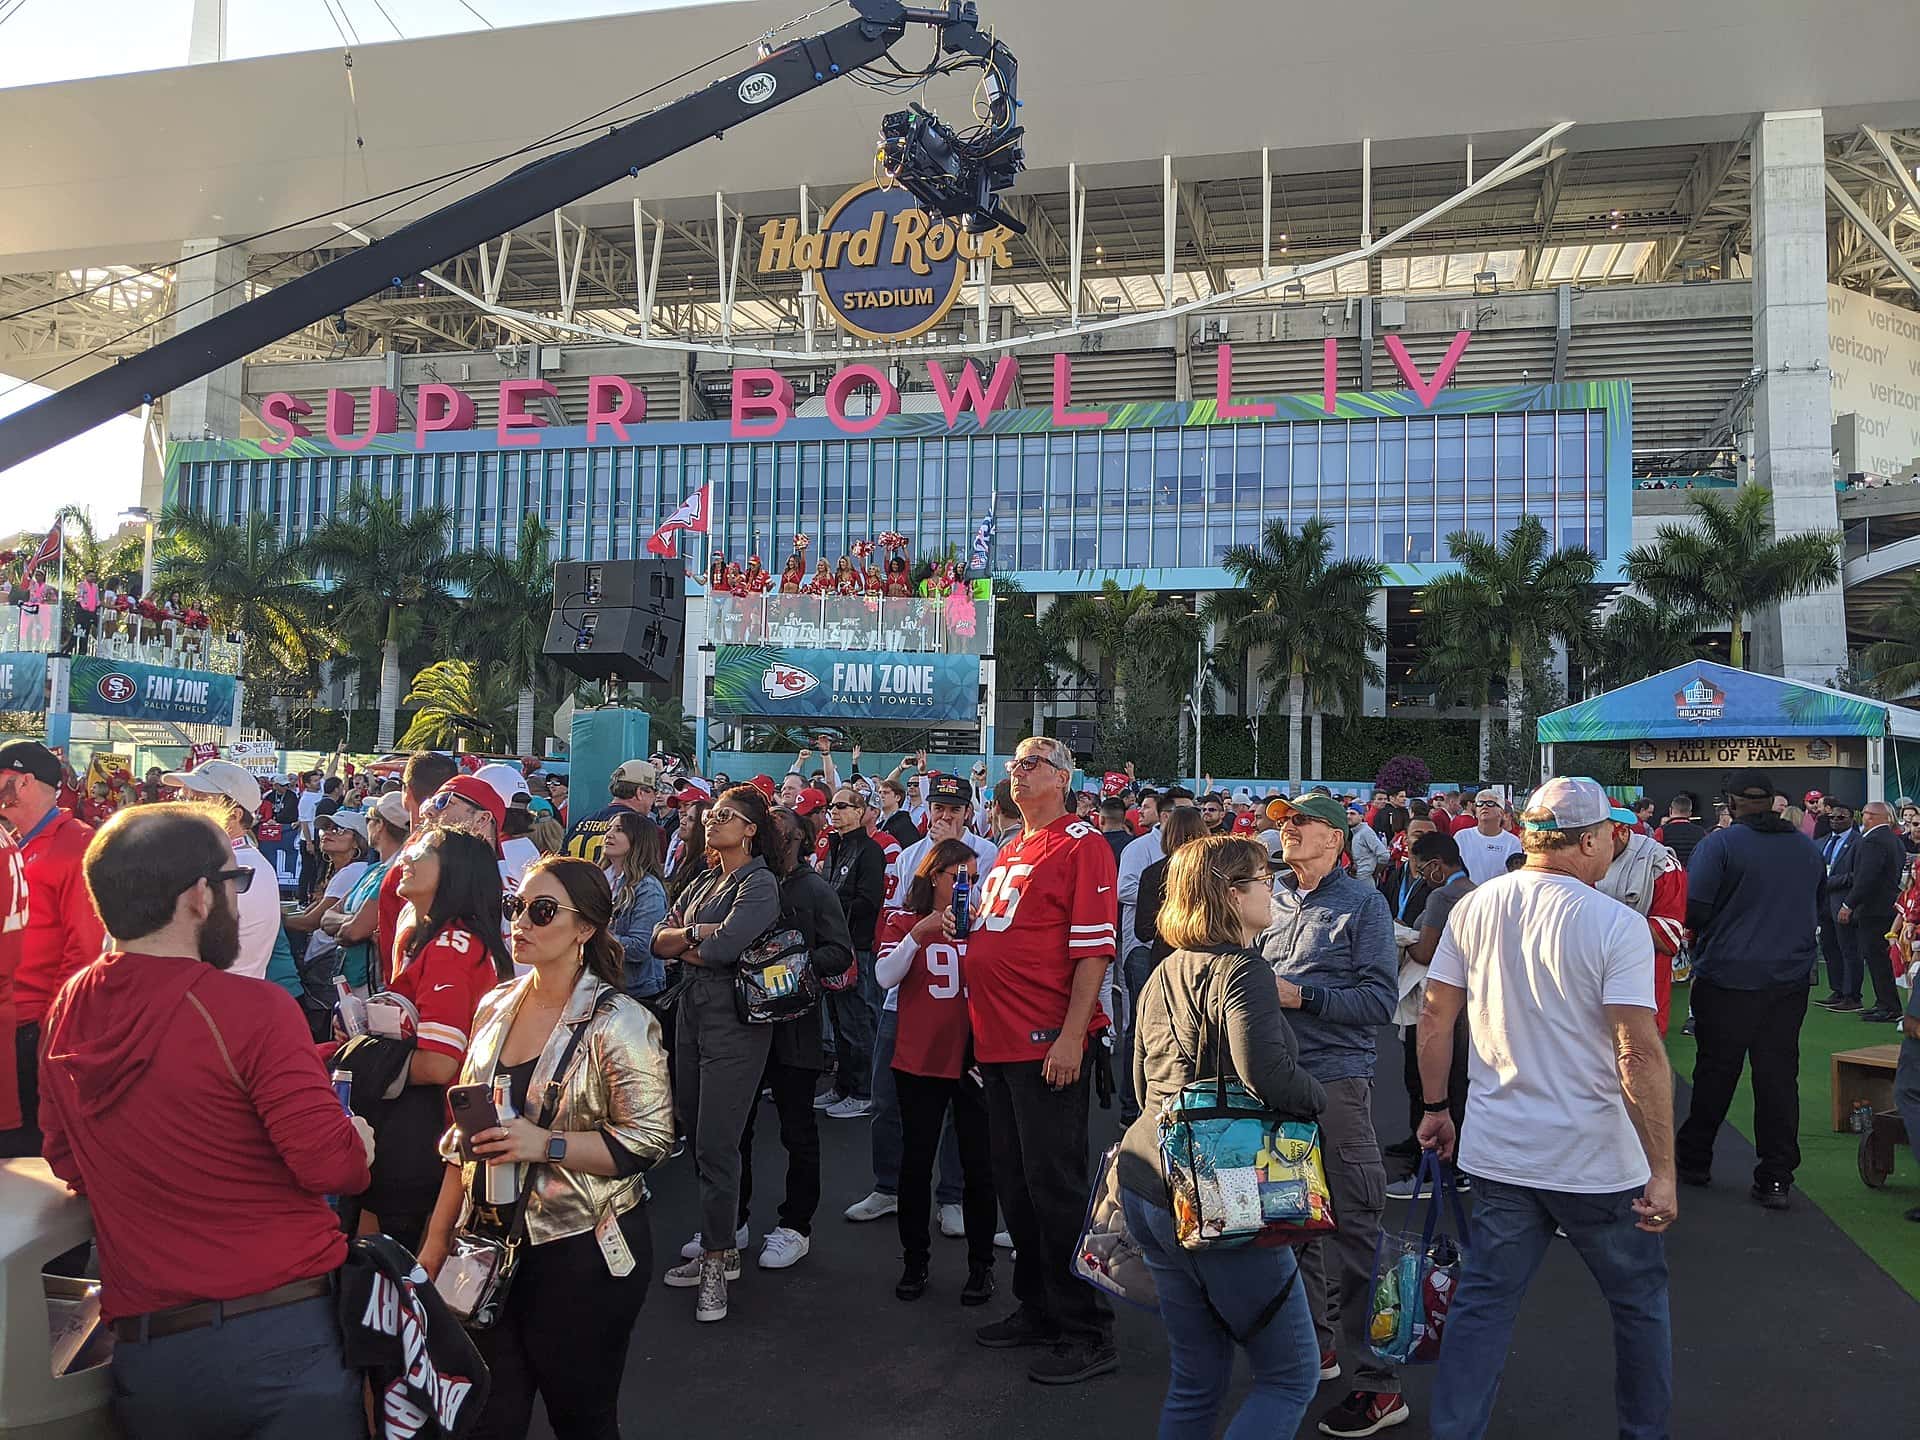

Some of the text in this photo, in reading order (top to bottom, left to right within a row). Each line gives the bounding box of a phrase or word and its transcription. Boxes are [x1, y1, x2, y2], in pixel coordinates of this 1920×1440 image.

[745, 77, 767, 96] FOX
[757, 208, 1014, 275] Hard Rock
[843, 287, 934, 310] STADIUM
[1828, 334, 1883, 366] verizon
[259, 330, 1471, 455] SUPER BOWL LIV
[146, 675, 209, 705] FAN ZONE
[833, 663, 934, 694] FAN ZONE
[144, 701, 208, 714] RALLY TOWELS
[832, 695, 933, 706] RALLY TOWELS
[1679, 737, 1782, 749] PRO FOOTBALL
[1666, 750, 1711, 763] HALL
[1717, 750, 1740, 762] OF
[1748, 749, 1796, 762] FAME
[435, 930, 472, 954] 15
[926, 943, 968, 999] 9
